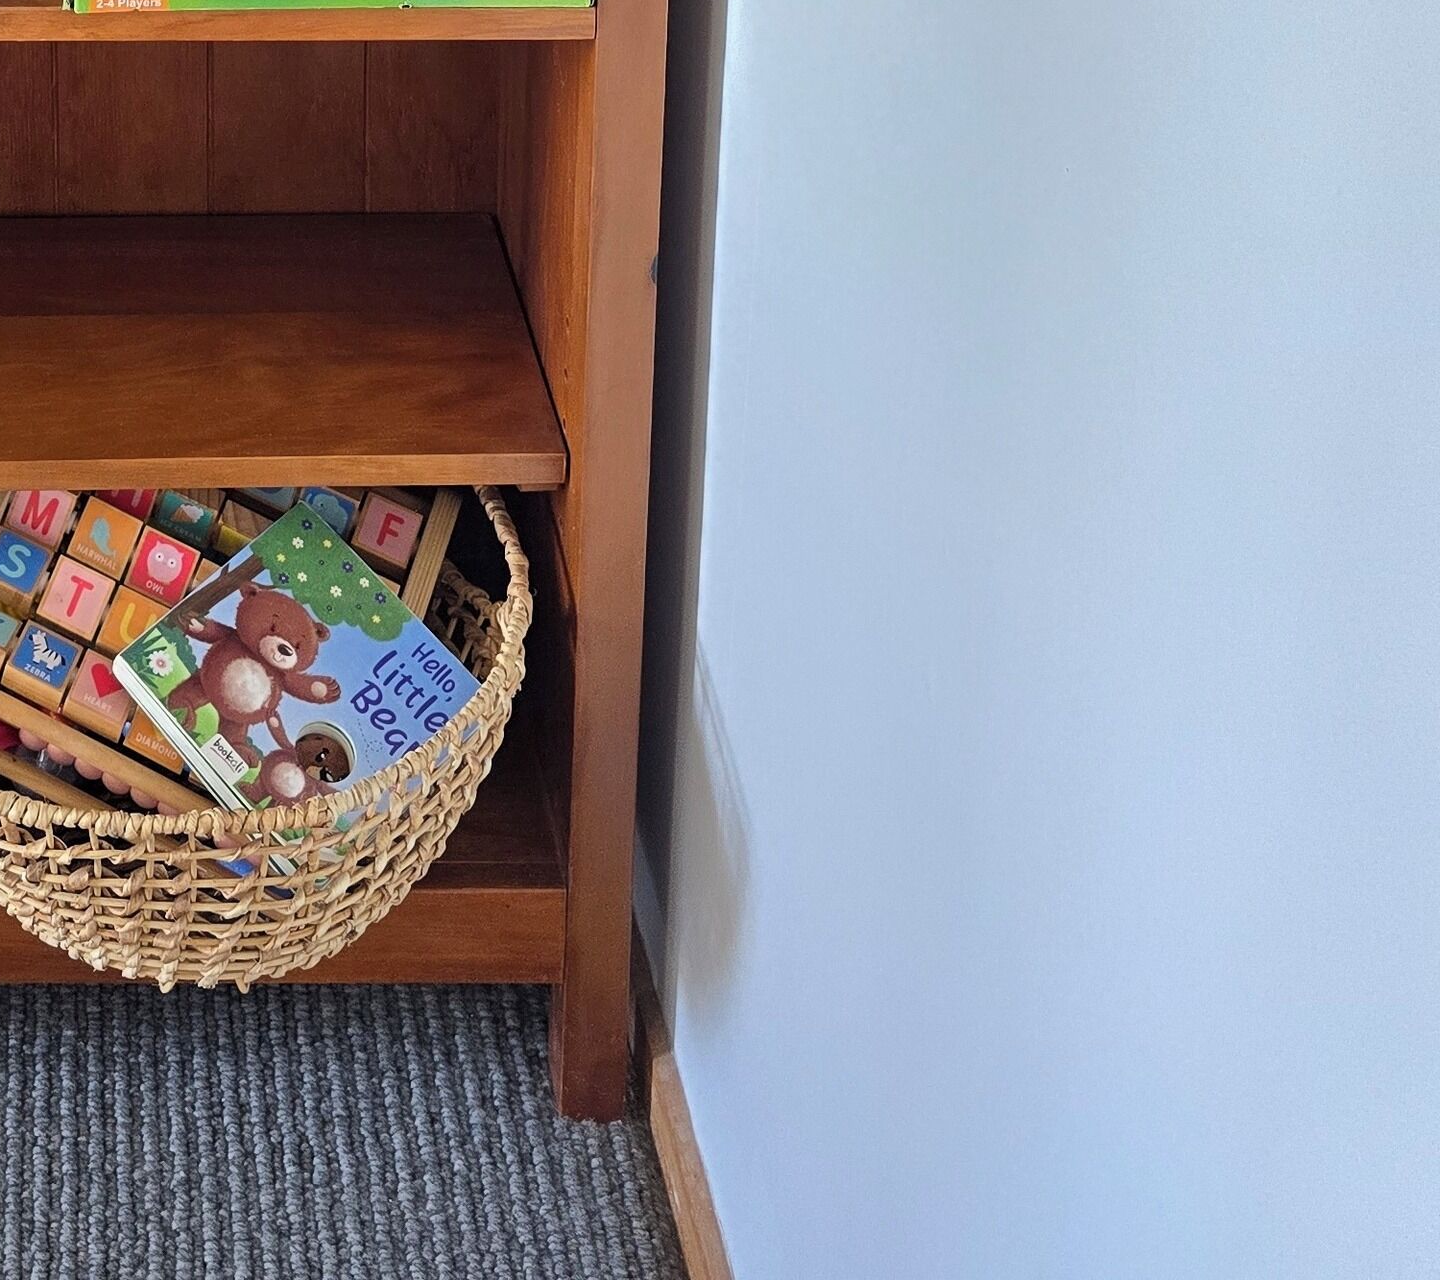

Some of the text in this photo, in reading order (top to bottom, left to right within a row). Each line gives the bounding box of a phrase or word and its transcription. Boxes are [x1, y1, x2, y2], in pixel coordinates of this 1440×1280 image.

[96, 0, 114, 8] 2-4
[20, 490, 59, 536] M
[376, 512, 405, 546] F
[0, 544, 32, 579] S
[76, 543, 117, 571] NARWHAL
[71, 575, 95, 618] T
[145, 579, 165, 595] OWL
[23, 663, 51, 682] ZEBRA
[411, 642, 456, 702] Hello,
[83, 694, 113, 712] HEART
[372, 649, 450, 734] Little
[135, 732, 178, 761] DIAMOND
[212, 737, 245, 774] bookoli
